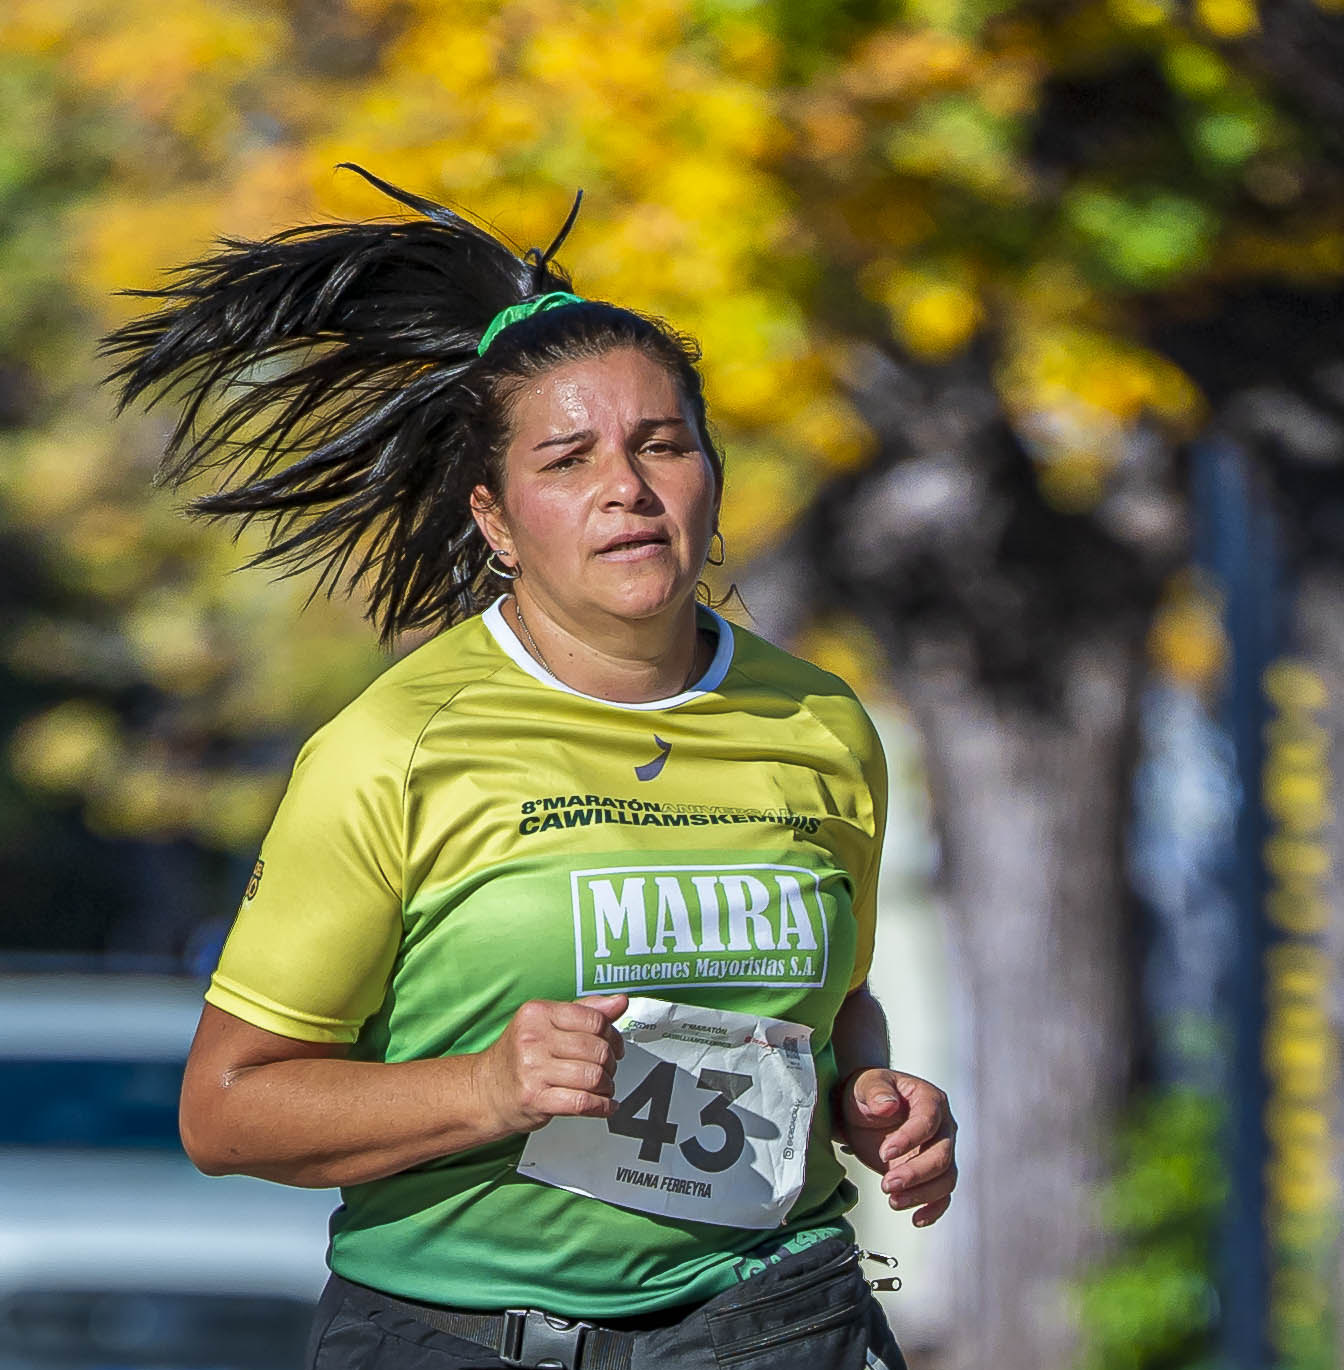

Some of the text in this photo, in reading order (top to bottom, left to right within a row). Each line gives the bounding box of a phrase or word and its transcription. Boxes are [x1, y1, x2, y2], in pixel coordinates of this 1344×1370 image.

[588, 875, 818, 958] MAIRA
[593, 956, 816, 985] Almacenes Mayoristas S.A.
[607, 1061, 754, 1173] 43
[616, 1166, 712, 1199] VIVIANA FERREYRA
